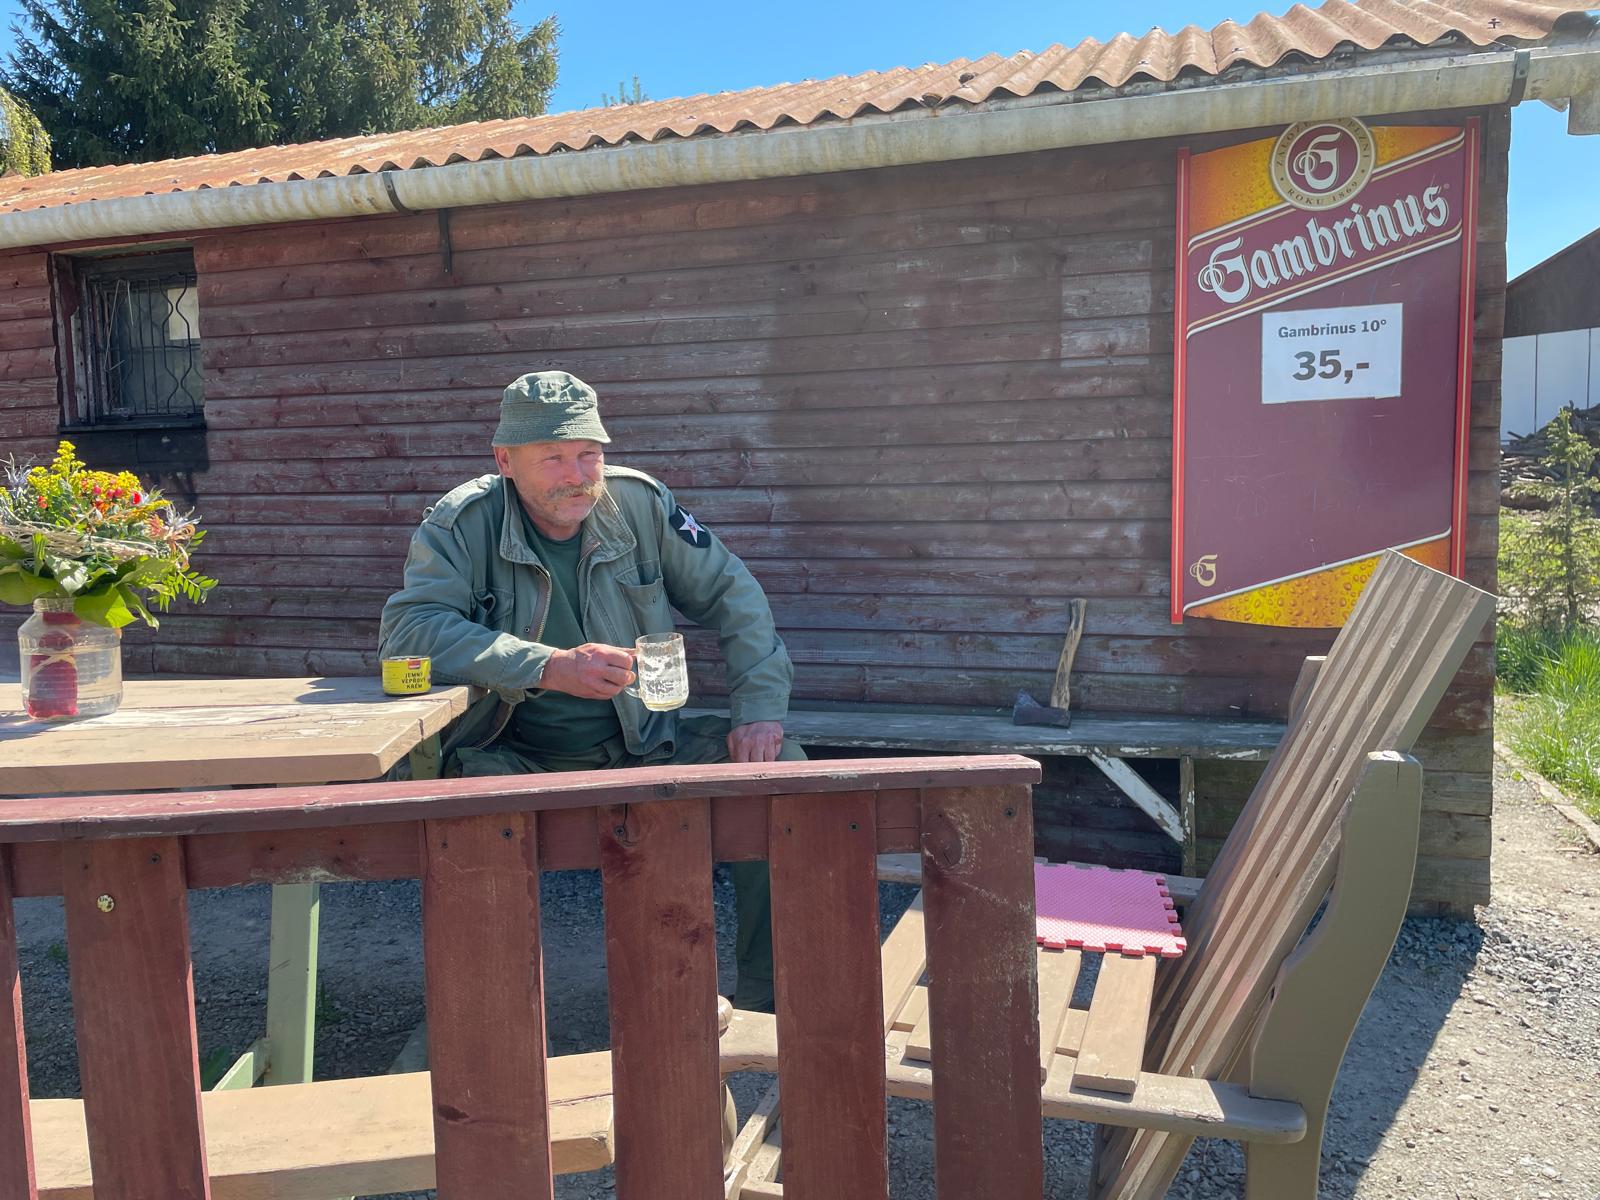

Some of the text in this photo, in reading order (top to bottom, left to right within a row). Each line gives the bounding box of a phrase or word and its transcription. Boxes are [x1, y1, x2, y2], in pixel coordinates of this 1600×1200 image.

[1287, 182, 1358, 205] ROKU 1869
[1197, 185, 1448, 304] Gambrinus
[1278, 319, 1387, 338] Gambrinus 10°
[1292, 349, 1370, 384] 35,-
